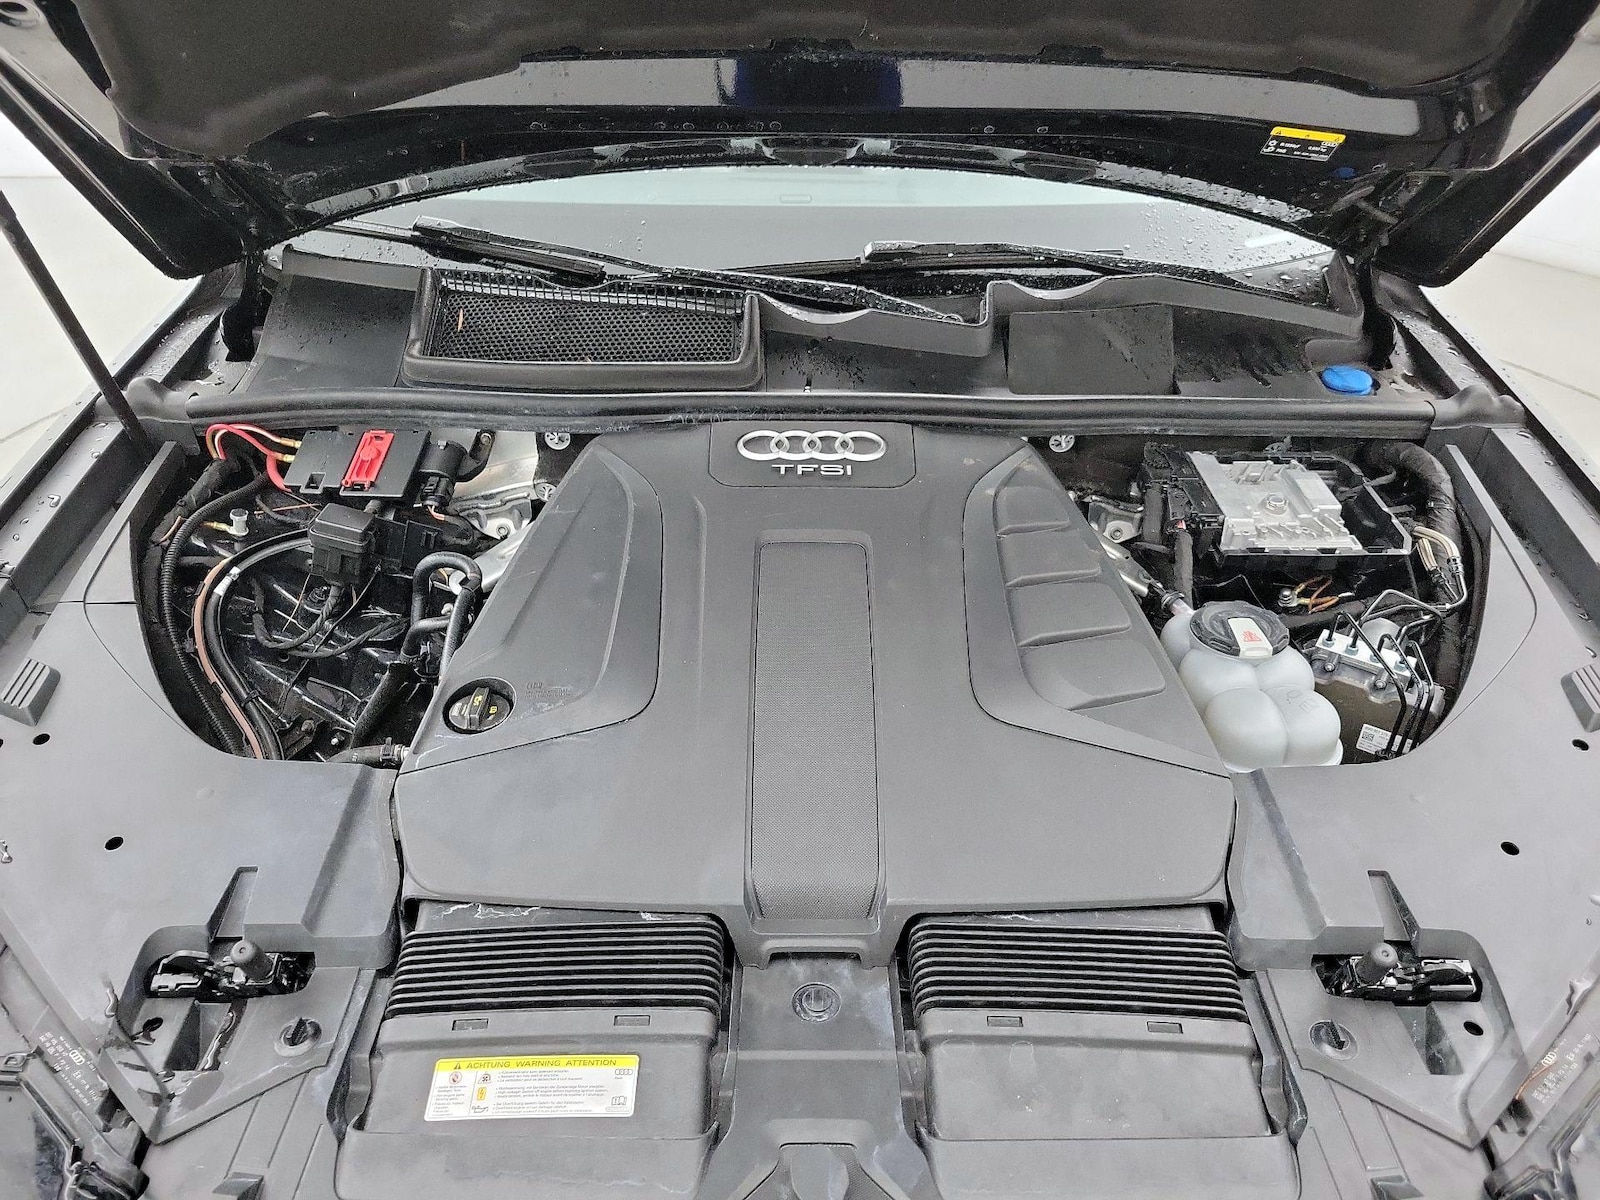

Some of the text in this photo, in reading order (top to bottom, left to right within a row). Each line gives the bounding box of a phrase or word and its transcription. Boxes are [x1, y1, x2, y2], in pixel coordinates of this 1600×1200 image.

[771, 464, 852, 476] TFSI
[466, 1061, 511, 1069] ACHTUNG
[565, 1059, 617, 1067] ATTENTION
